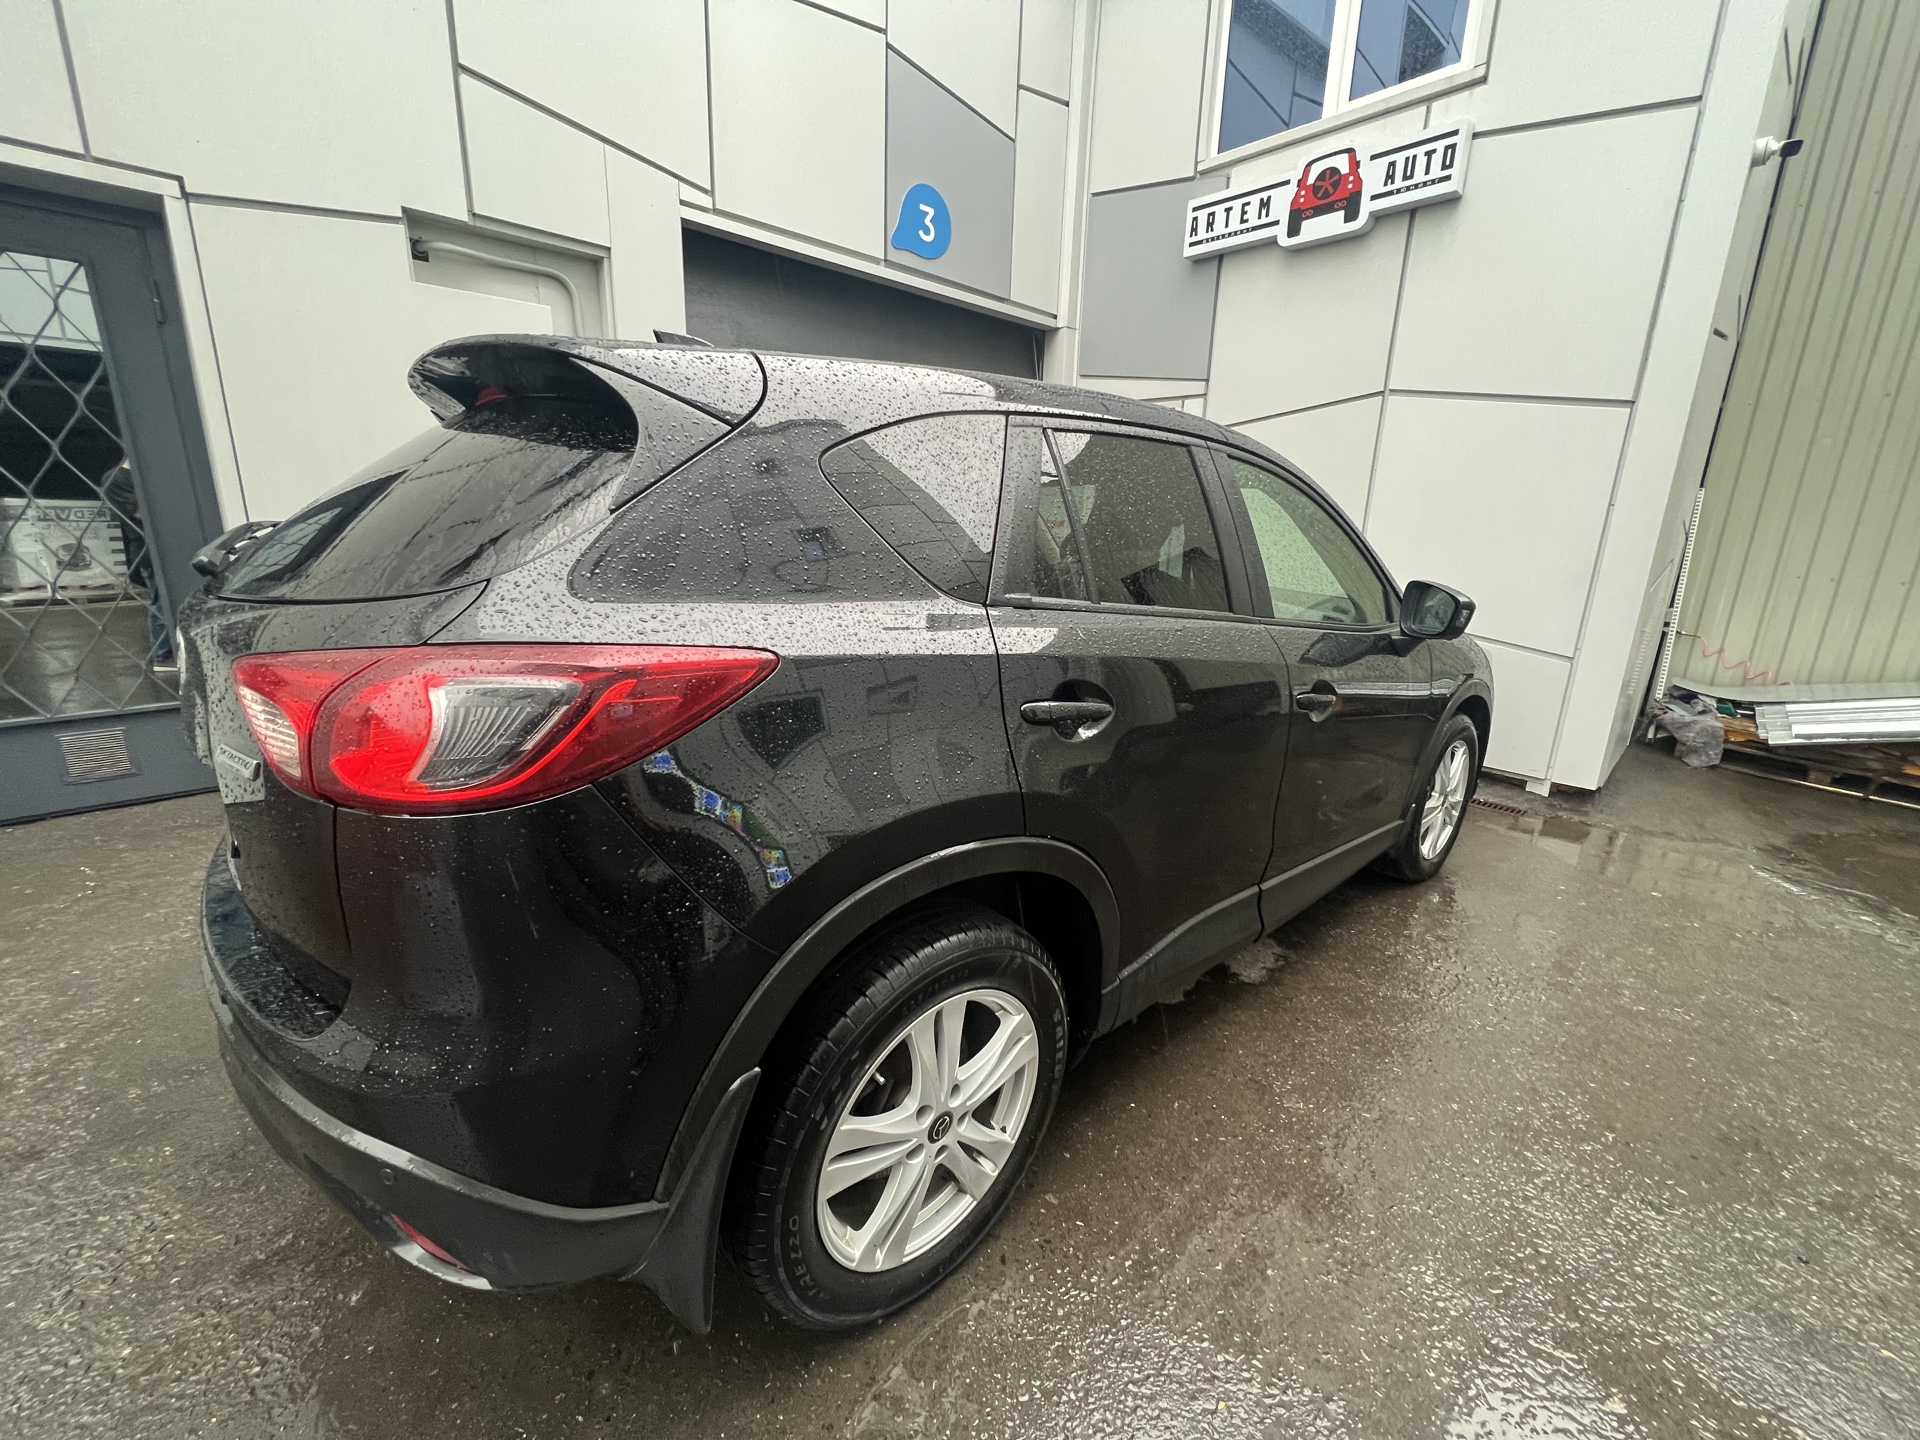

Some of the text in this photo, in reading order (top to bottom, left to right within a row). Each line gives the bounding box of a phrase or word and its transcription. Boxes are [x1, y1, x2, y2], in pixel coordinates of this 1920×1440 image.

[1189, 142, 1458, 238] ARTEM AUTO
[1392, 178, 1440, 195] ТЮНИНГ
[918, 203, 936, 243] 3
